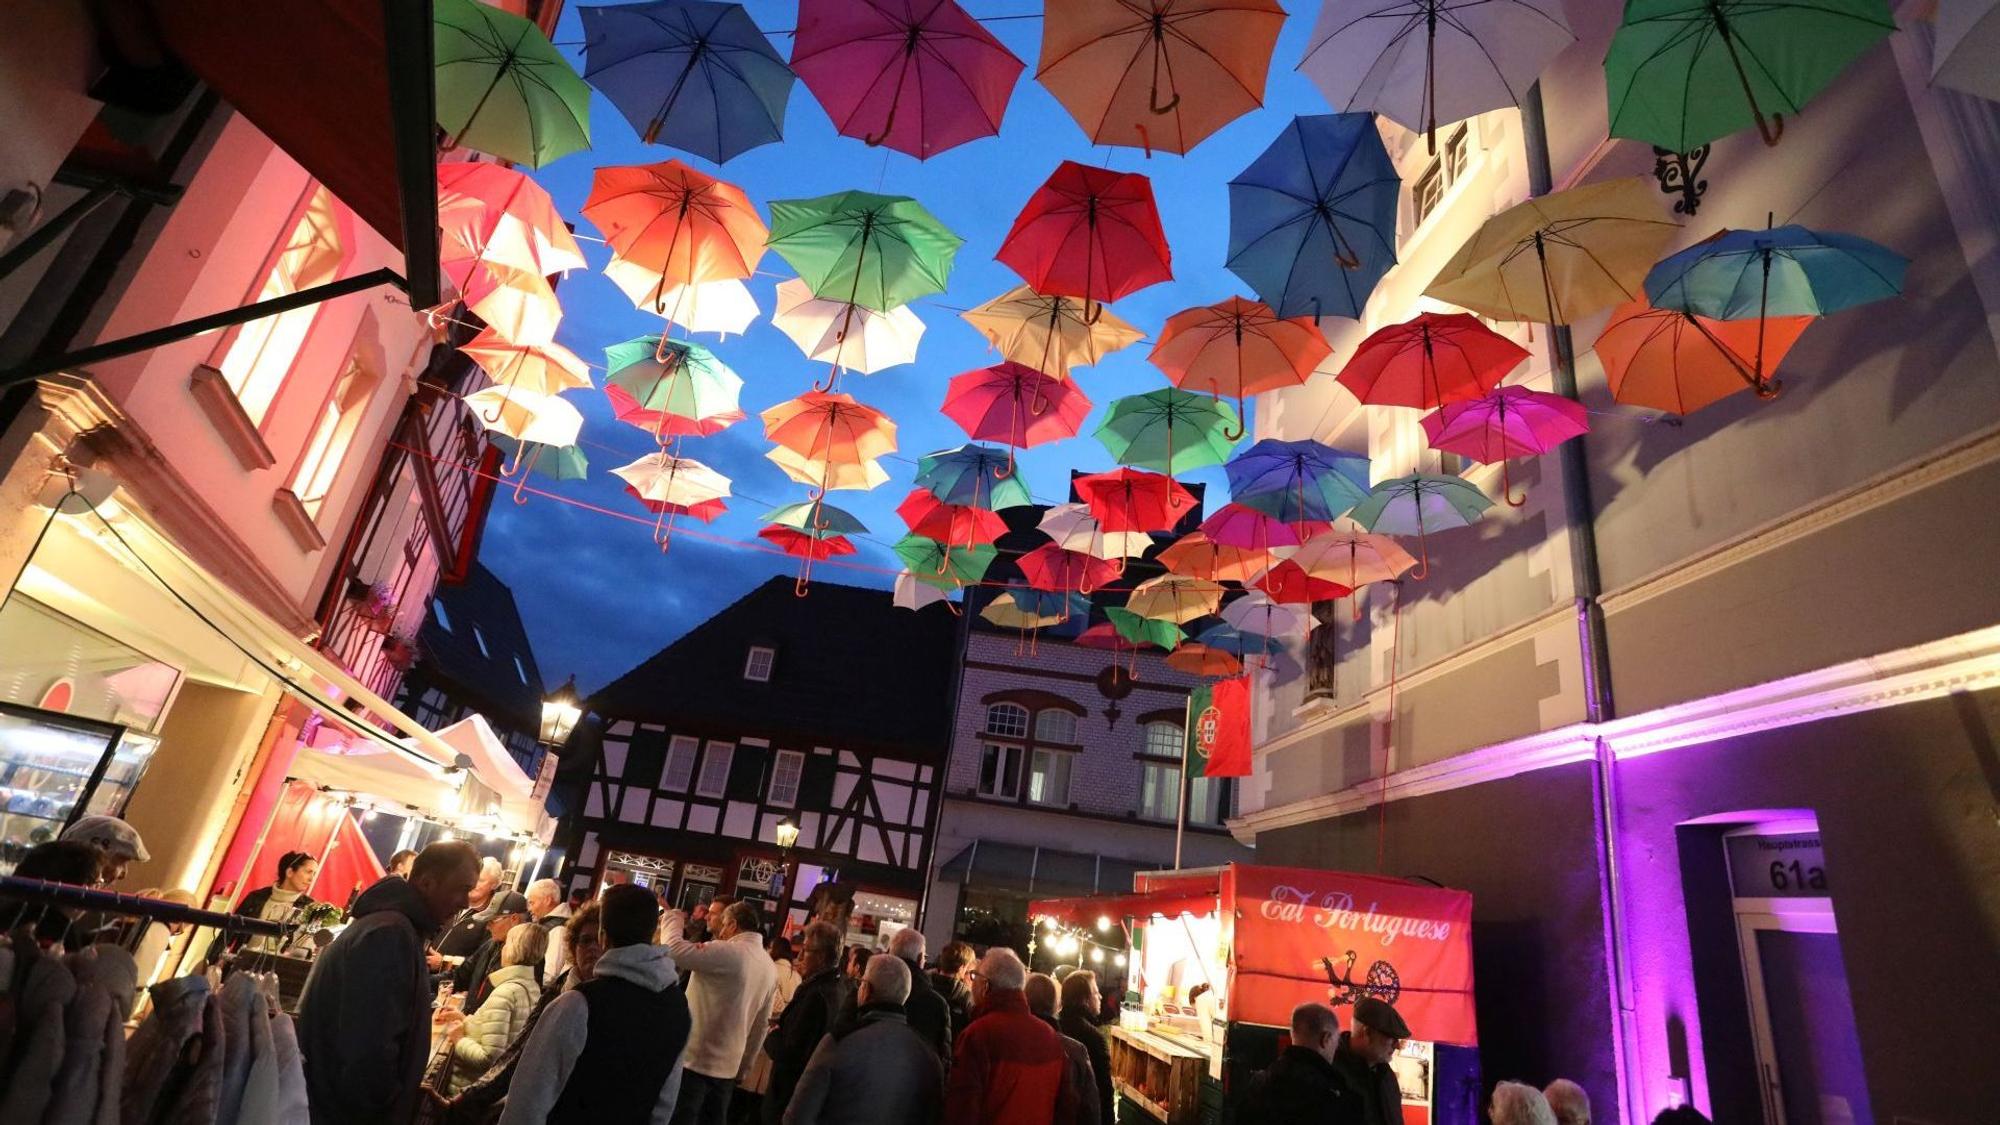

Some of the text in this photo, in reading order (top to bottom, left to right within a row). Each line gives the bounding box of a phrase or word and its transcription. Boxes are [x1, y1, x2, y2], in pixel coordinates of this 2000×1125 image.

[1758, 838, 1821, 851] Hauptstrass
[1770, 860, 1827, 890] 61a
[1260, 885, 1450, 946] Eat Portuguese
